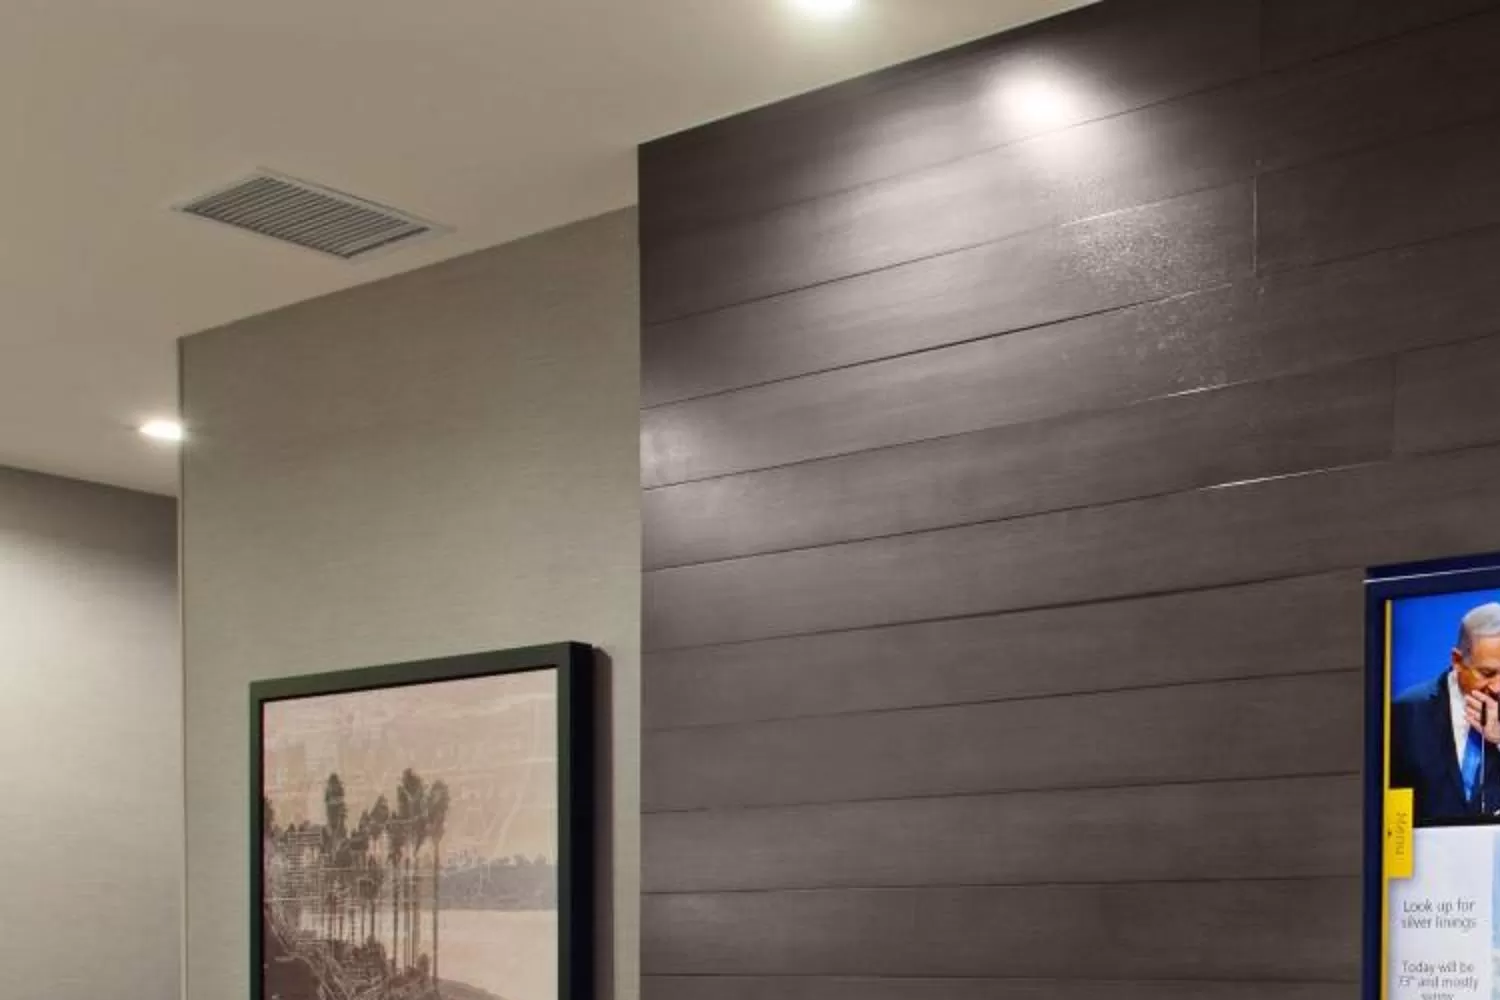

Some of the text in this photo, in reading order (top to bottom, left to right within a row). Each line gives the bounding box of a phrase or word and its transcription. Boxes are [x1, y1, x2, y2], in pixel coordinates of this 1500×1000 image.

[1403, 899, 1476, 917] Look up for
[1402, 914, 1477, 933] silver linings
[1402, 960, 1474, 977] Today will be
[1418, 975, 1439, 989] and
[1442, 976, 1479, 992] mostly
